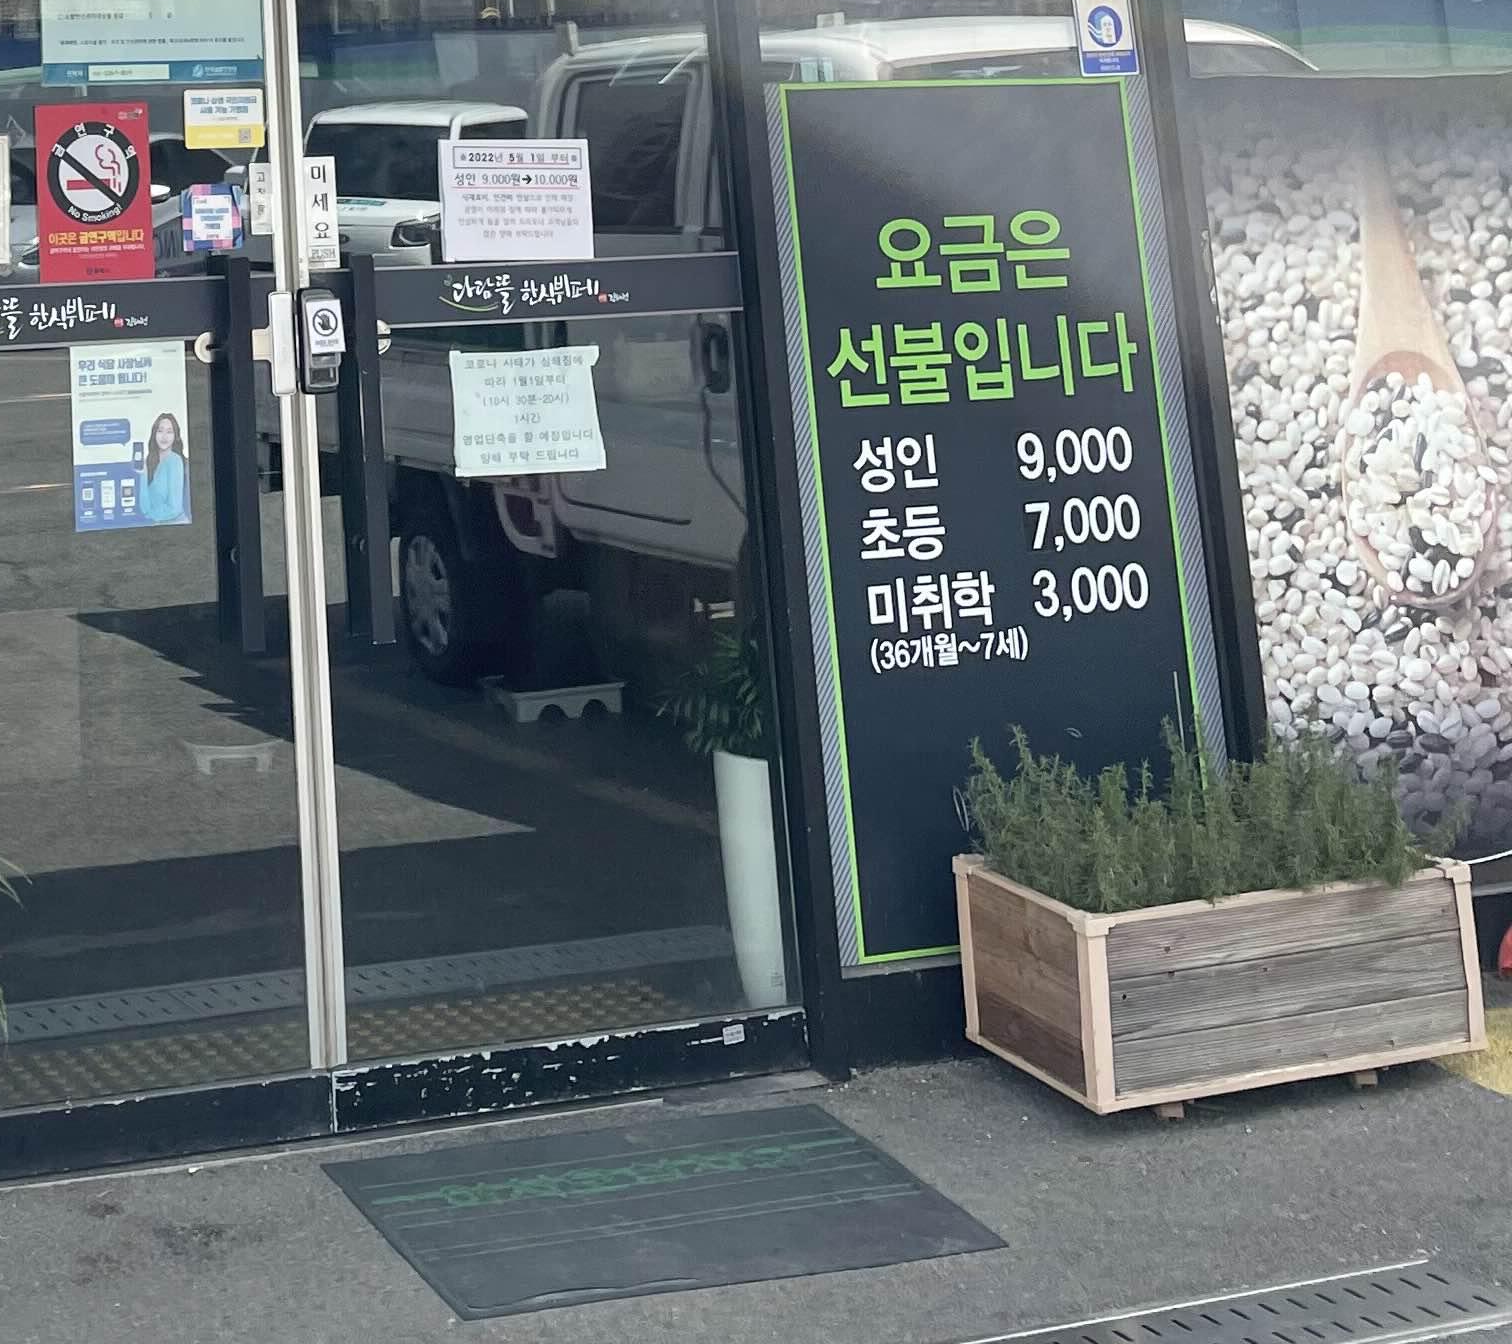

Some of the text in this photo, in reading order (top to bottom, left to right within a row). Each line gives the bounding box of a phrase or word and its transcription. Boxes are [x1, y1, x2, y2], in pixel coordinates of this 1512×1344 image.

[454, 173, 476, 186] 성인
[468, 153, 503, 162] 2022년
[68, 205, 81, 219] No
[310, 164, 330, 239] 미세요
[48, 229, 144, 245] 이곳은 금연구역입니다
[876, 210, 1071, 293] 요금은
[29, 297, 116, 330] 한식뷔페
[454, 273, 599, 315] 다람뜰 한식뷔페
[827, 312, 1138, 408] 선불입니다
[852, 426, 1134, 493] 성인 9,000
[860, 493, 1141, 561] 초등 7,000
[867, 562, 1150, 633] 미취학 3,000
[871, 625, 1029, 673] (36개월~7세)
